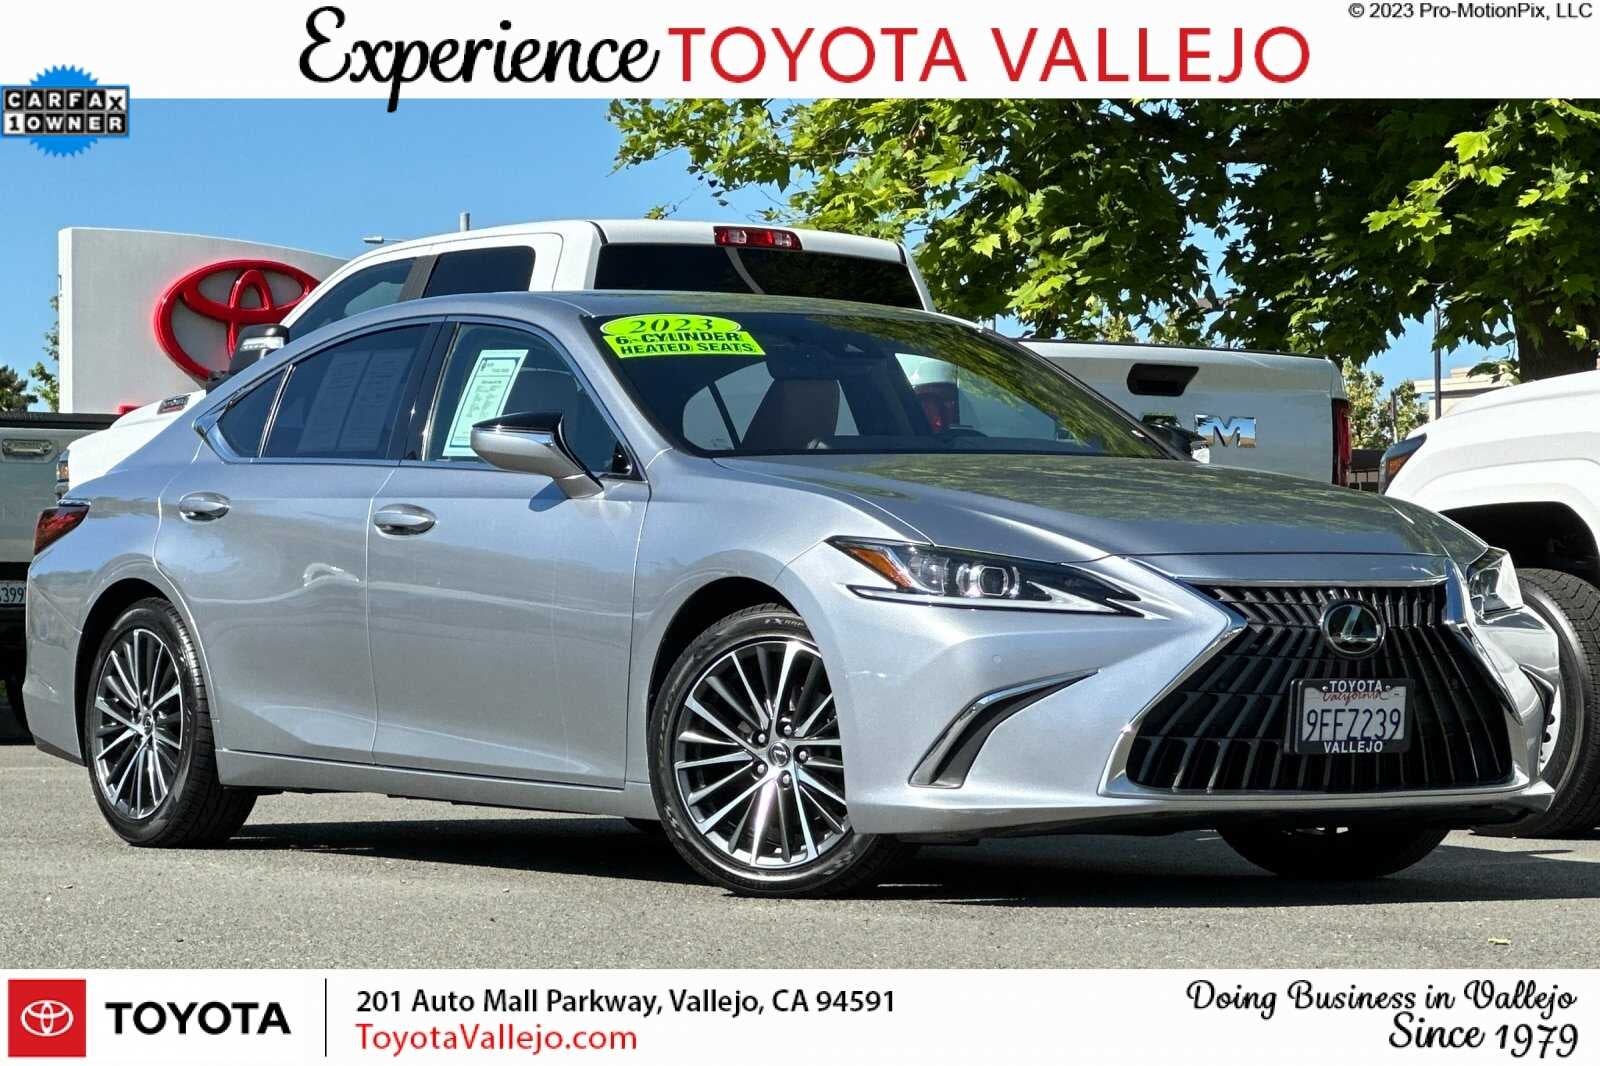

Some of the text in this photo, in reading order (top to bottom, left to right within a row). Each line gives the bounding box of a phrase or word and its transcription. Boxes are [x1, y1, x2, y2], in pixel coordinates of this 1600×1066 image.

[629, 318, 714, 334] 2023
[621, 341, 755, 355] HEATED SEATS
[1329, 679, 1383, 693] TOYOTA
[1305, 708, 1401, 741] 9FFZ239
[1323, 740, 1384, 754] VALLEJO
